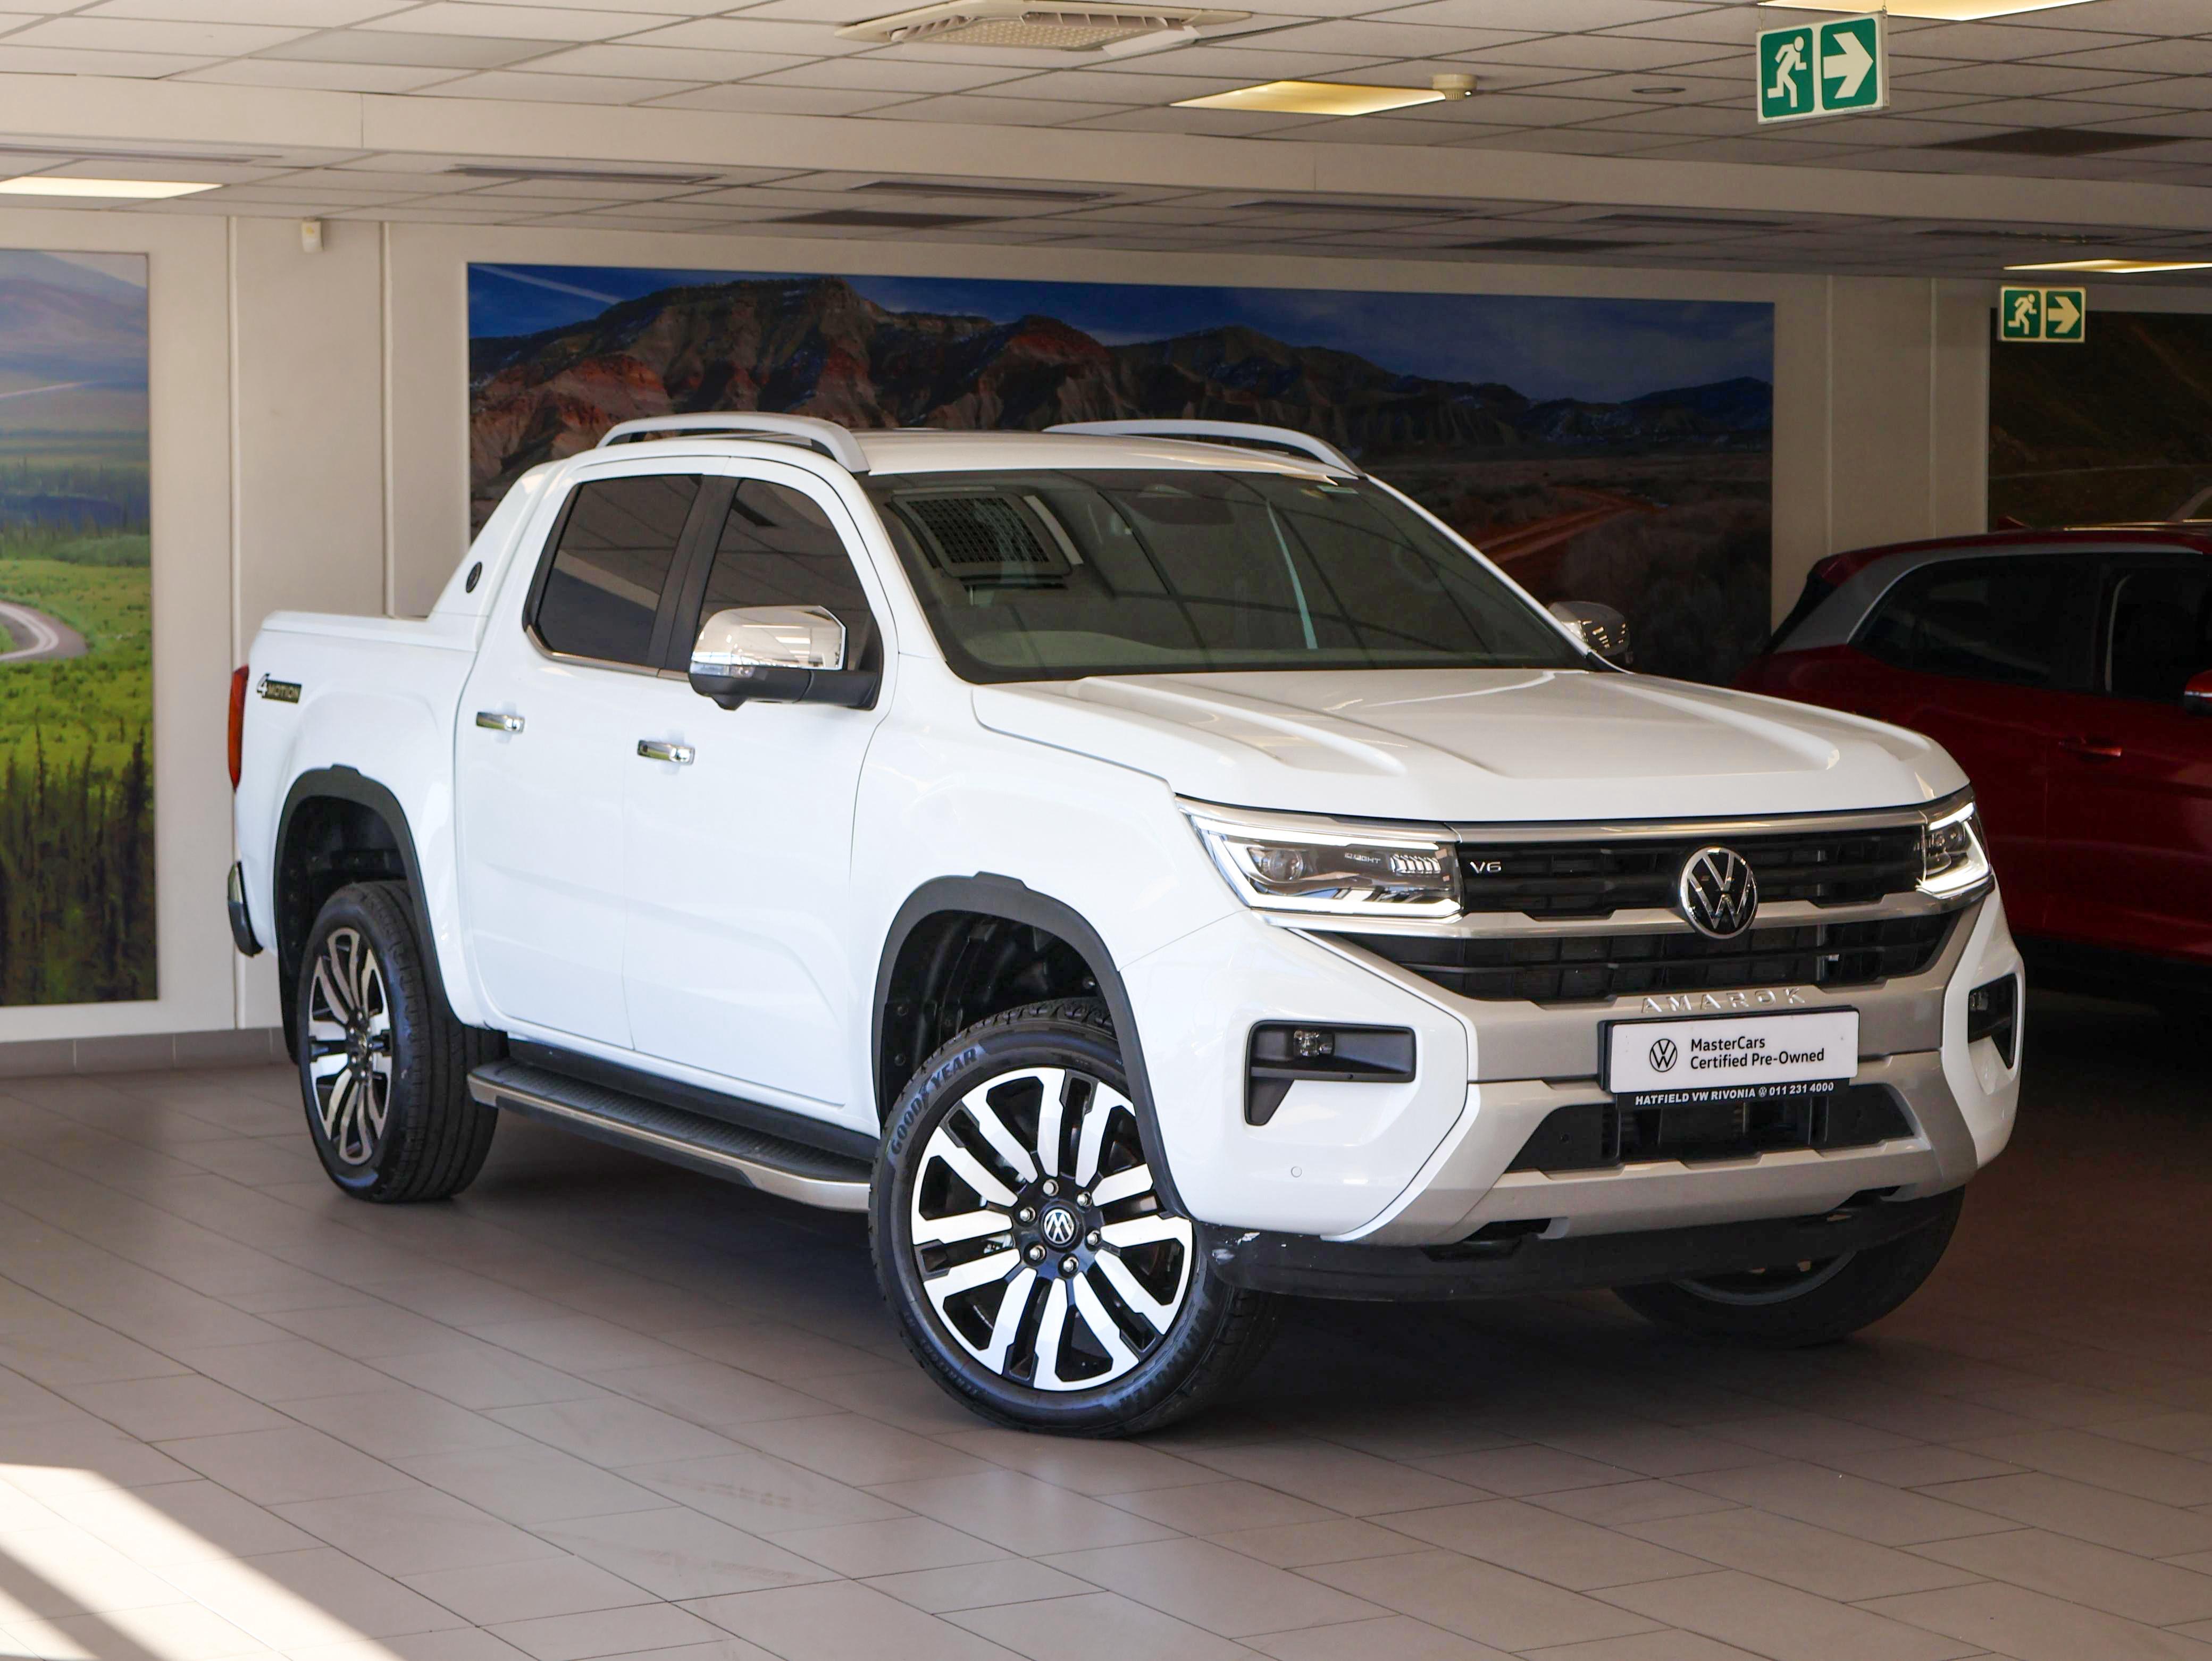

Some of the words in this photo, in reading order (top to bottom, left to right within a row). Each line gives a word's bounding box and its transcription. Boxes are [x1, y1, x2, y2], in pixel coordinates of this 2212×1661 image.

[1470, 861, 1501, 874] V6
[1680, 846, 1758, 939] VW
[1641, 987, 1805, 1013] AMAROK
[1649, 1038, 1678, 1072] VW
[1691, 1036, 1765, 1052] MasterCars
[1690, 1053, 1747, 1069] Certified
[1752, 1048, 1824, 1066] Pre-Owned
[891, 1047, 977, 1155] GOODYEAR
[1635, 1093, 1689, 1105] HATFIELD
[1692, 1091, 1708, 1101] VW
[1711, 1088, 1755, 1101] RIVONIA
[1769, 1086, 1787, 1096] 011
[1789, 1084, 1807, 1094] 231
[1809, 1081, 1834, 1092] 4000
